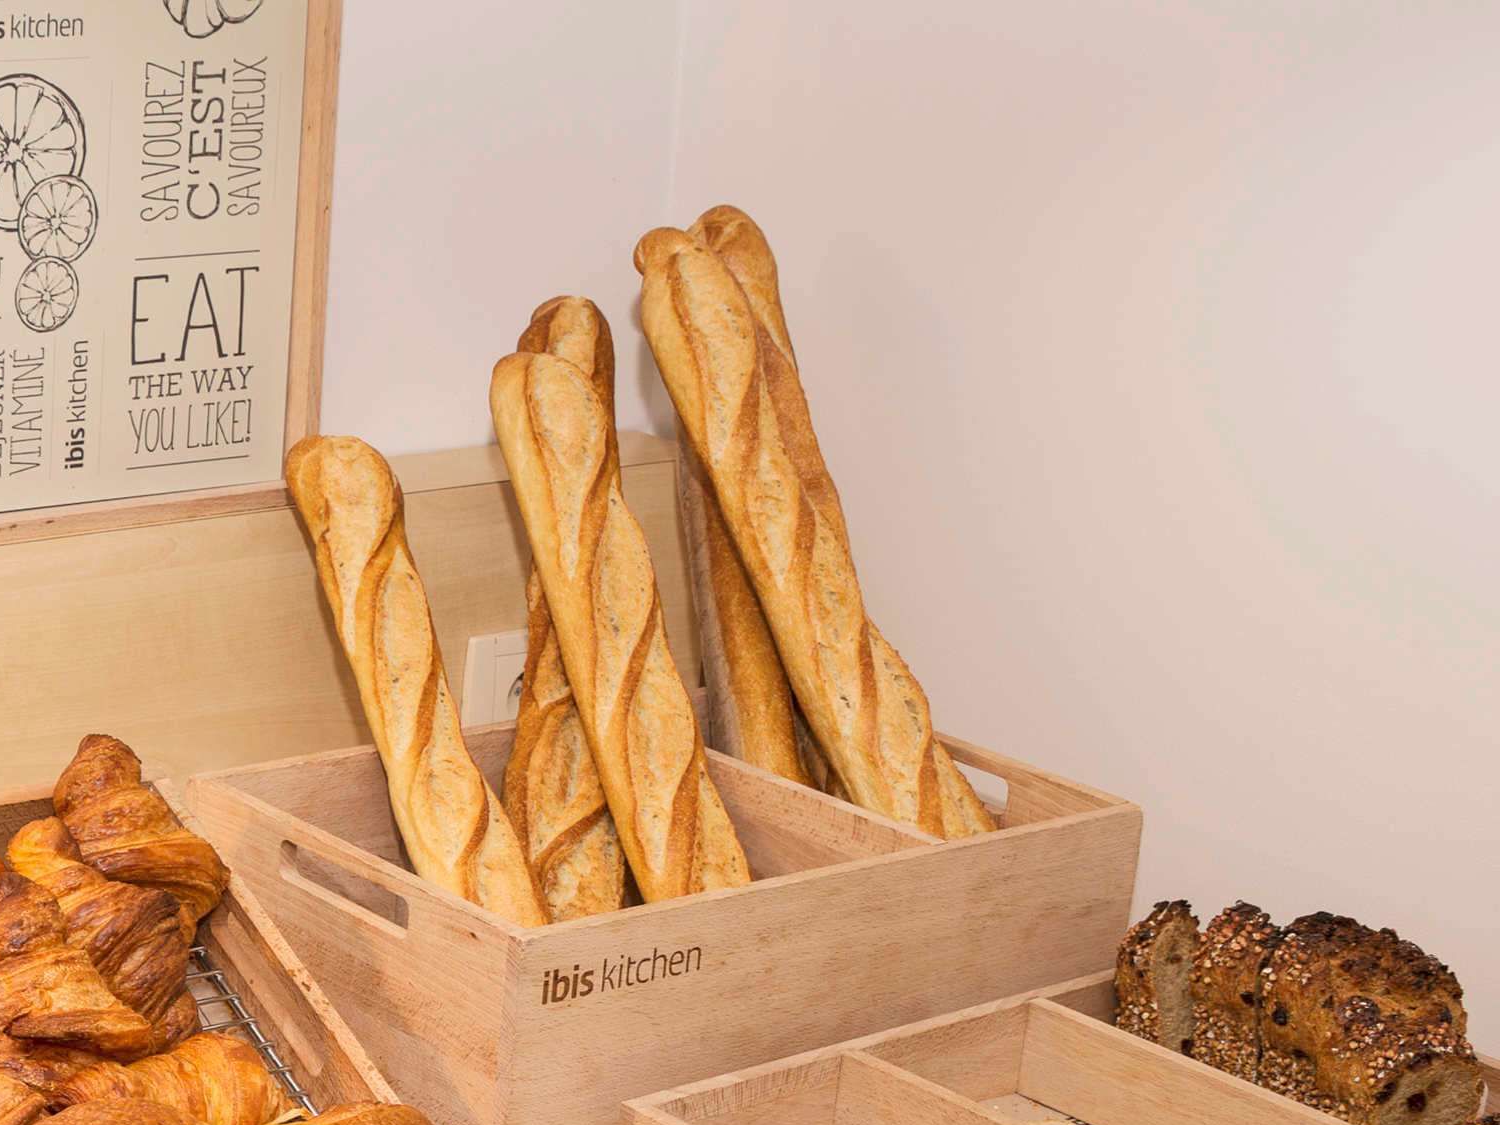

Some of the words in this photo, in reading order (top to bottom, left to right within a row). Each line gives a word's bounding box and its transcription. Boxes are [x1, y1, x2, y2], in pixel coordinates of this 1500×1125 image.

[10, 13, 84, 39] kitchen
[139, 60, 185, 222] SAVOUREZ
[186, 60, 226, 219] C'EST
[226, 56, 268, 217] SAVOUREUX
[131, 266, 260, 365] EAT
[9, 347, 45, 476] VITAMINÉ
[66, 340, 89, 423] kitchen
[128, 371, 183, 401] THE
[190, 365, 254, 394] WAY
[64, 427, 85, 470] ibis
[127, 406, 176, 455] YOU
[186, 398, 252, 449] LIKE!
[541, 964, 595, 1005] ibis
[601, 946, 702, 993] kitchen
